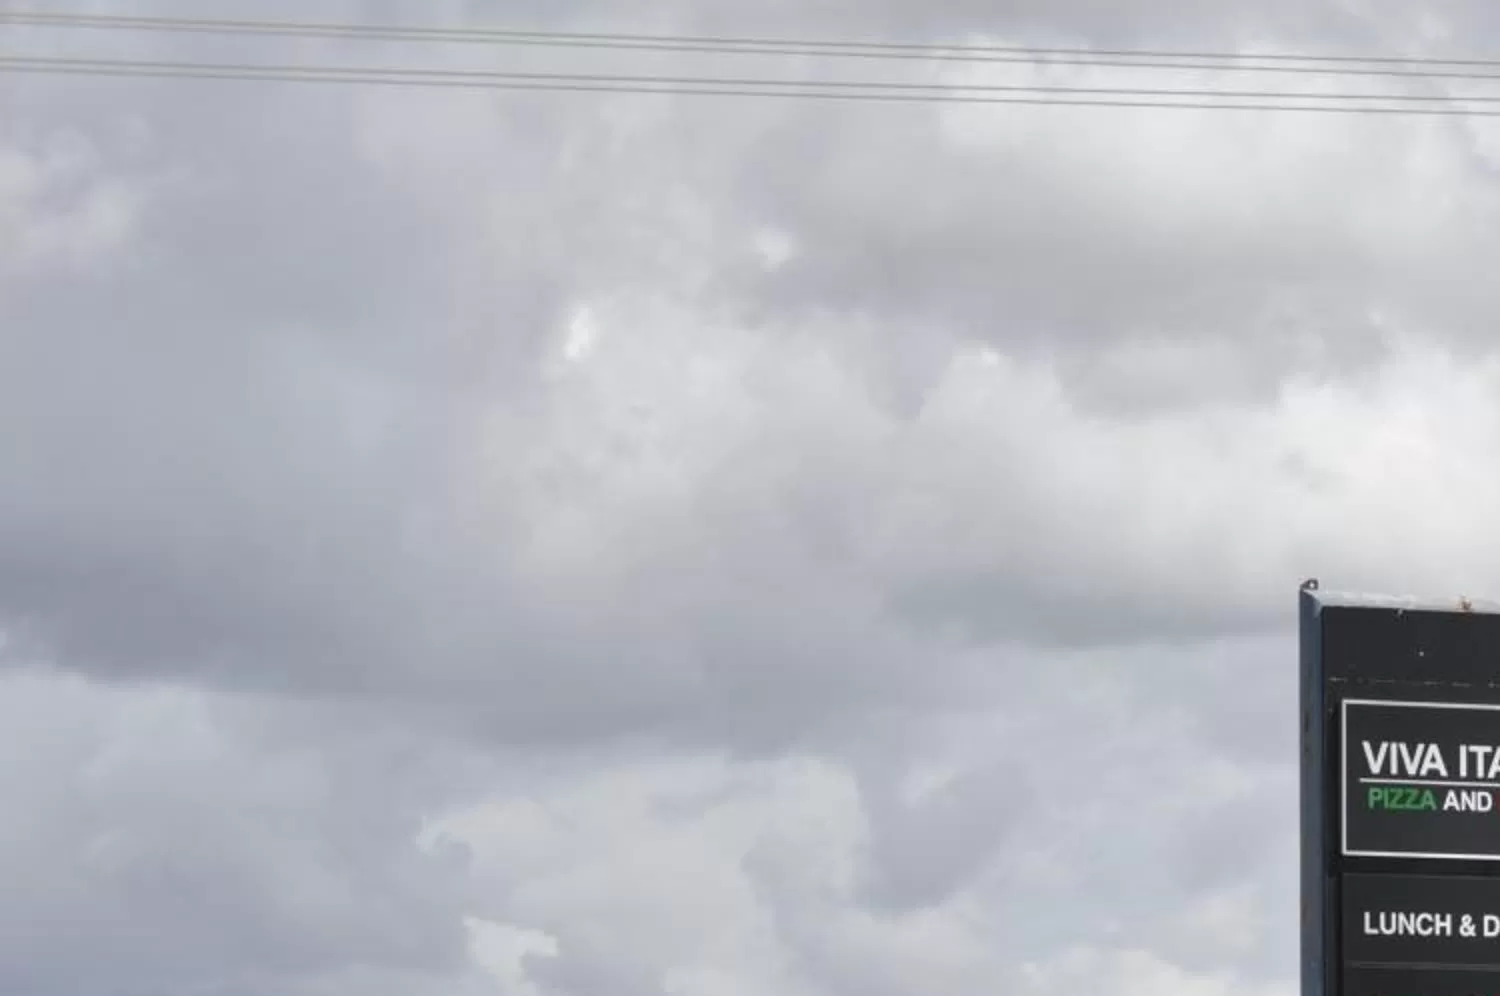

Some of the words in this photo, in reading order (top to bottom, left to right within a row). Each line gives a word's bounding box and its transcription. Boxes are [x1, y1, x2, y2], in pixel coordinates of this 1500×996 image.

[1362, 740, 1448, 777] VIVA
[1368, 787, 1437, 811] PIZZA
[1442, 789, 1493, 812] AND
[1363, 911, 1452, 936] LUNCH
[1458, 914, 1477, 937] &
